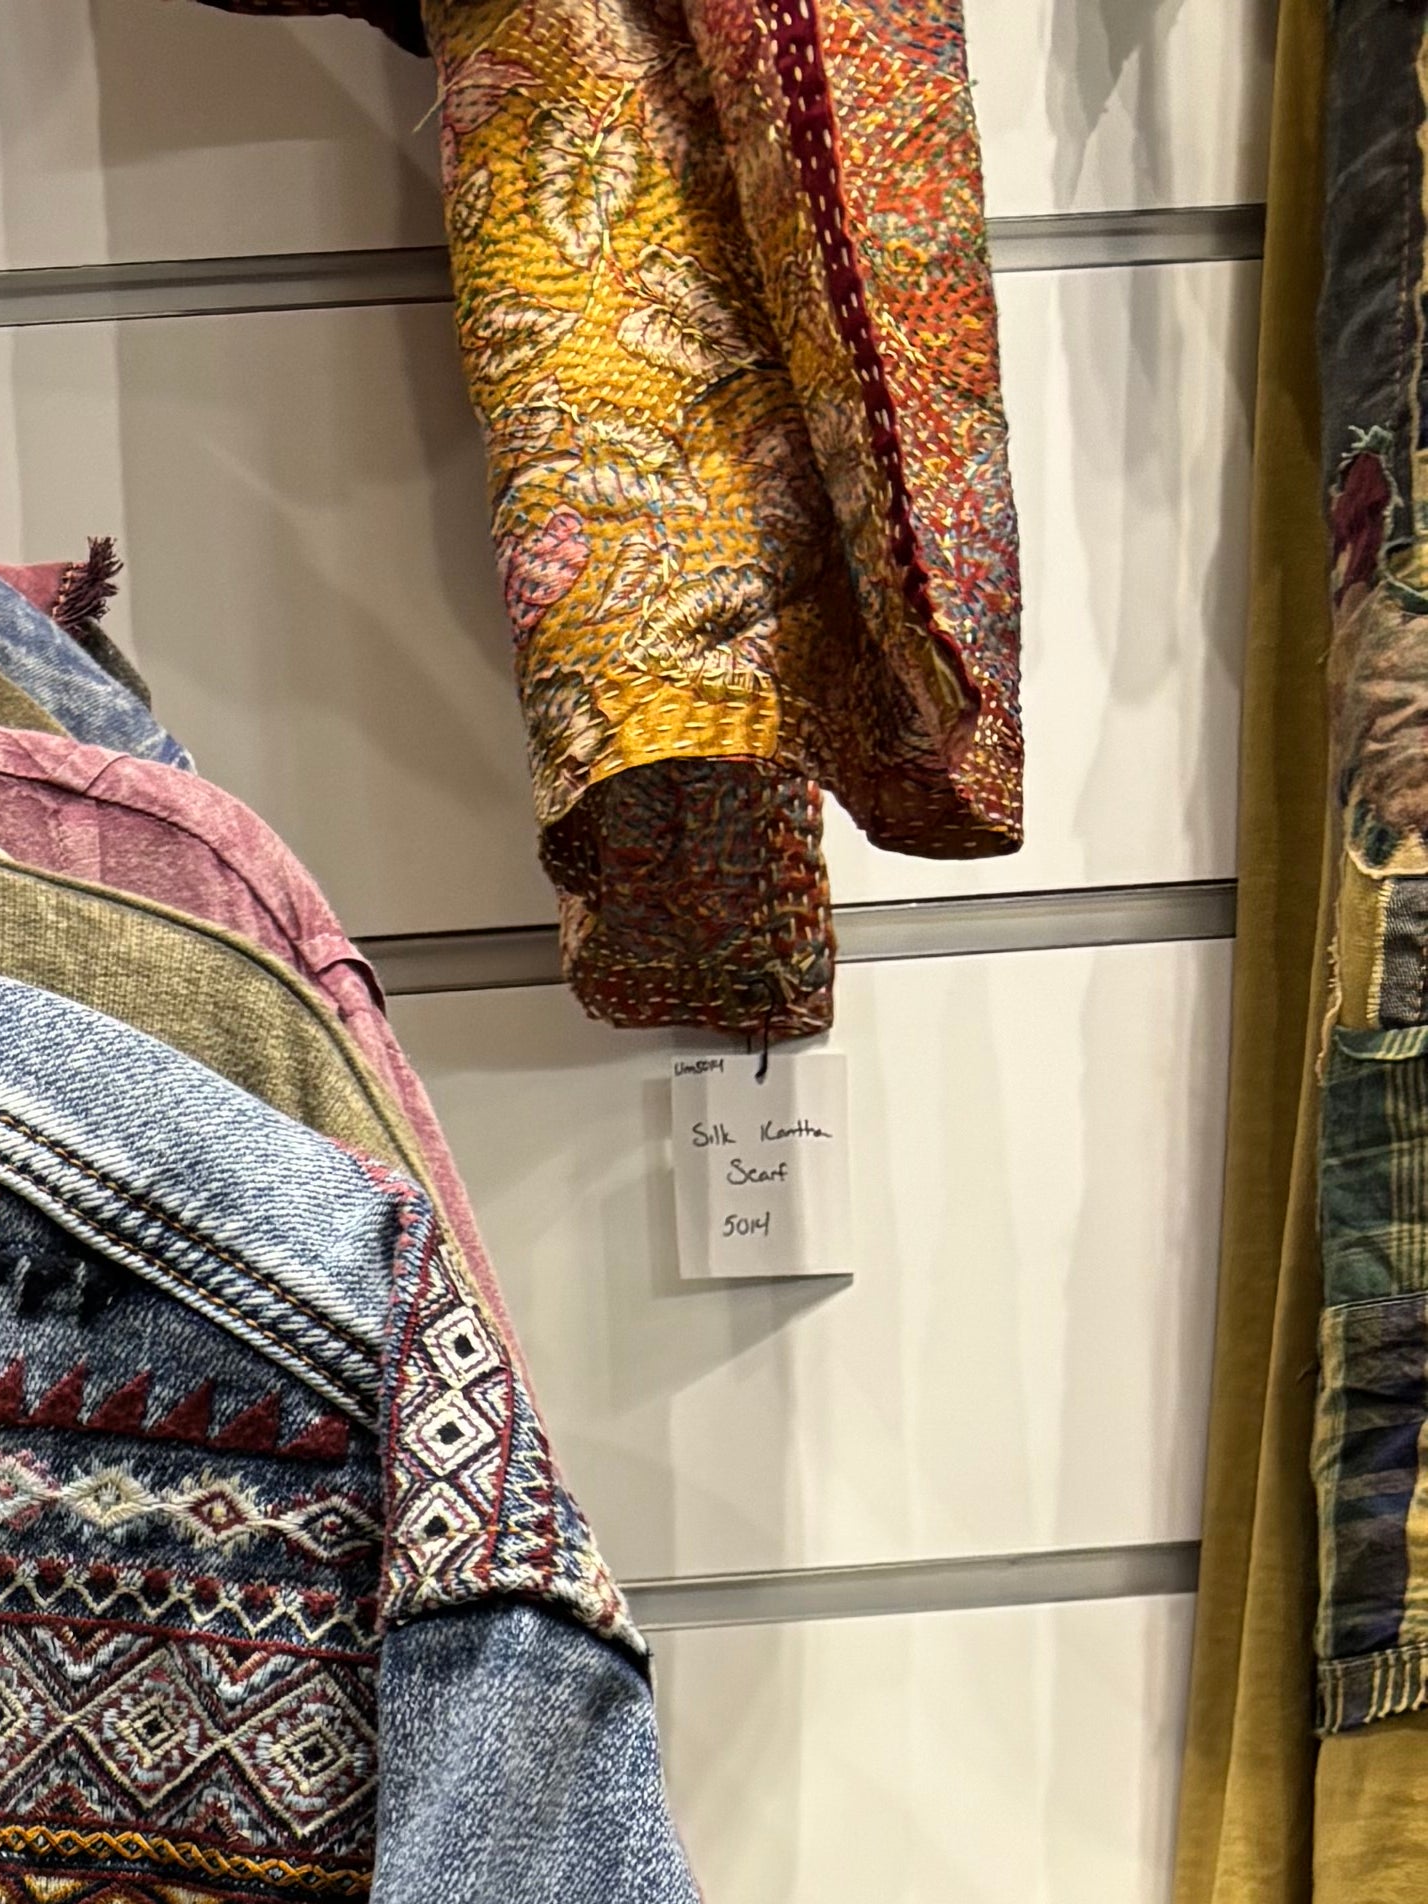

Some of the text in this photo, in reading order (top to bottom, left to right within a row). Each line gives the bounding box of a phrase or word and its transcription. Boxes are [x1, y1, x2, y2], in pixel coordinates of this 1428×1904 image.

[692, 1122, 736, 1147] Silk
[726, 1158, 788, 1185] Scarf
[722, 1211, 770, 1237] 5014
